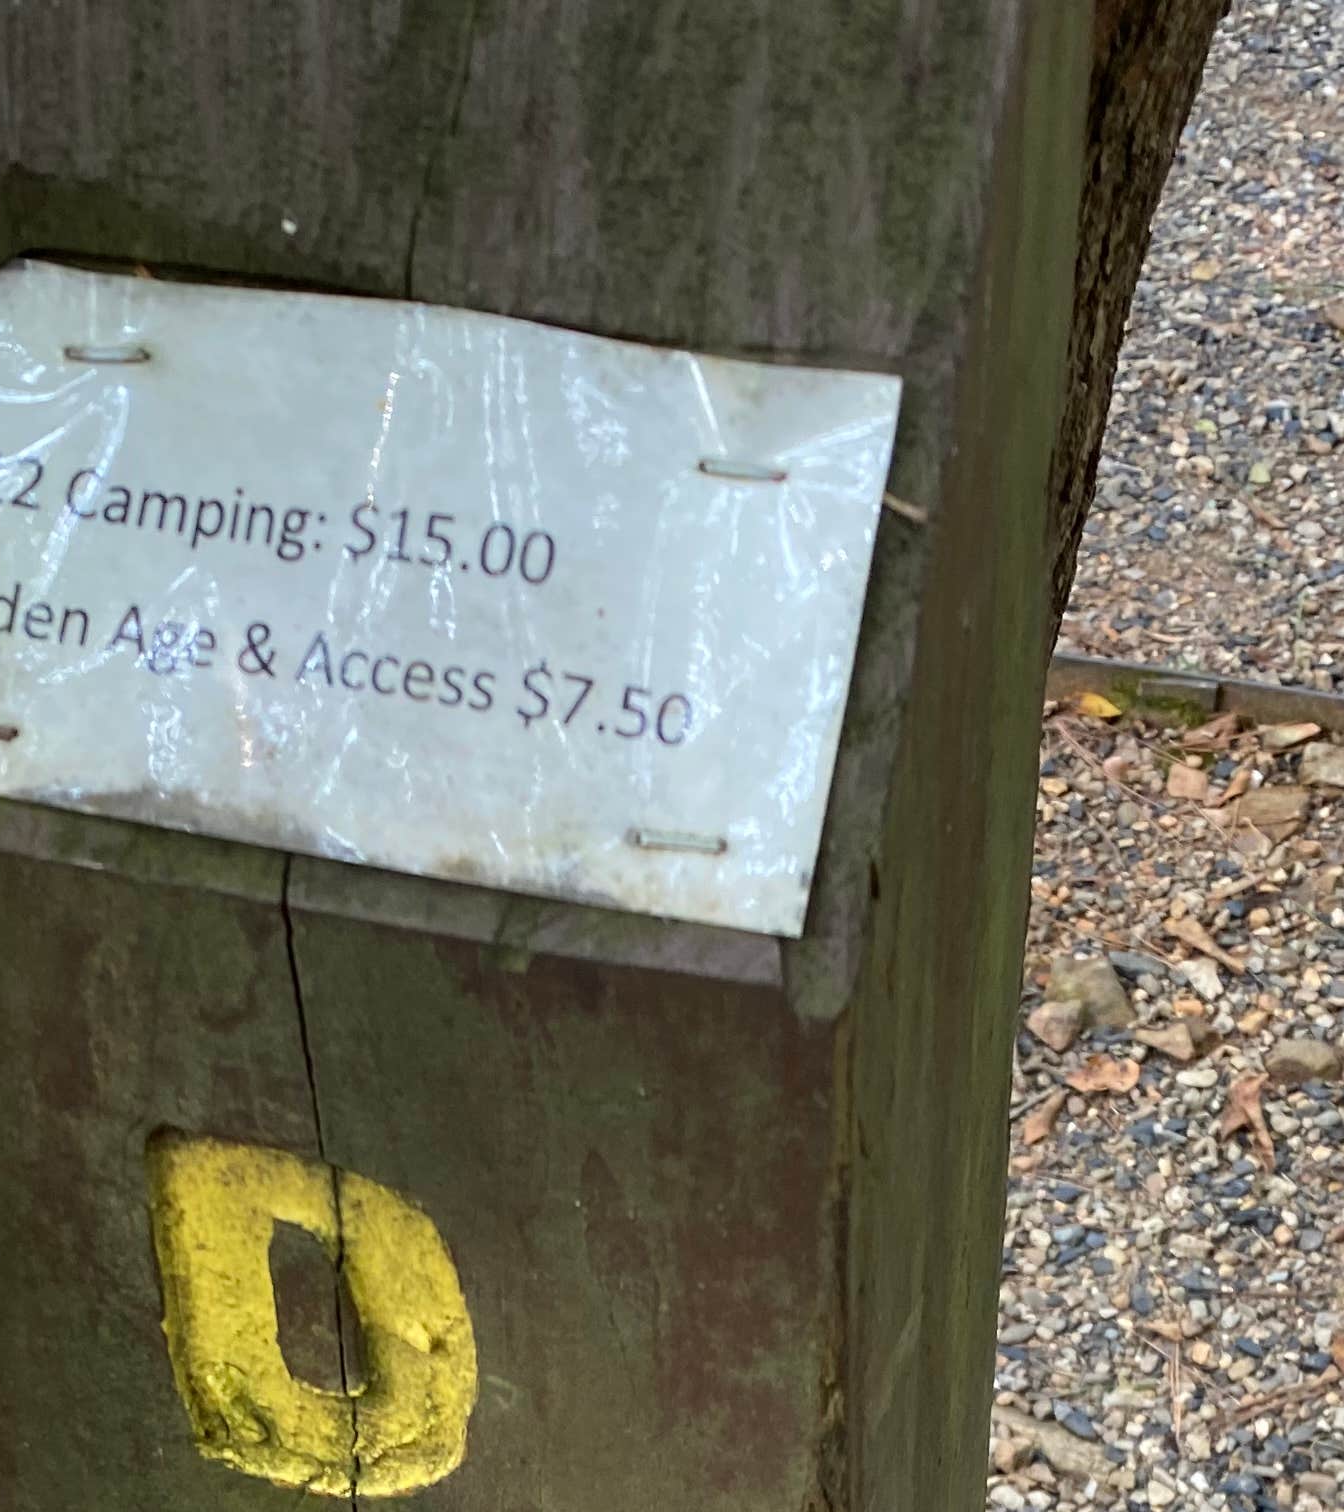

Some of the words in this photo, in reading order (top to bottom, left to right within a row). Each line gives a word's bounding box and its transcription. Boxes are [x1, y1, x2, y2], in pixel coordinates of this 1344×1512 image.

[66, 469, 328, 562] Camping:
[346, 503, 556, 584] $15.00
[111, 605, 218, 675] Age
[237, 623, 276, 678] &
[294, 631, 496, 712] Access
[516, 657, 694, 746] $7.50
[146, 1128, 479, 1498] D
